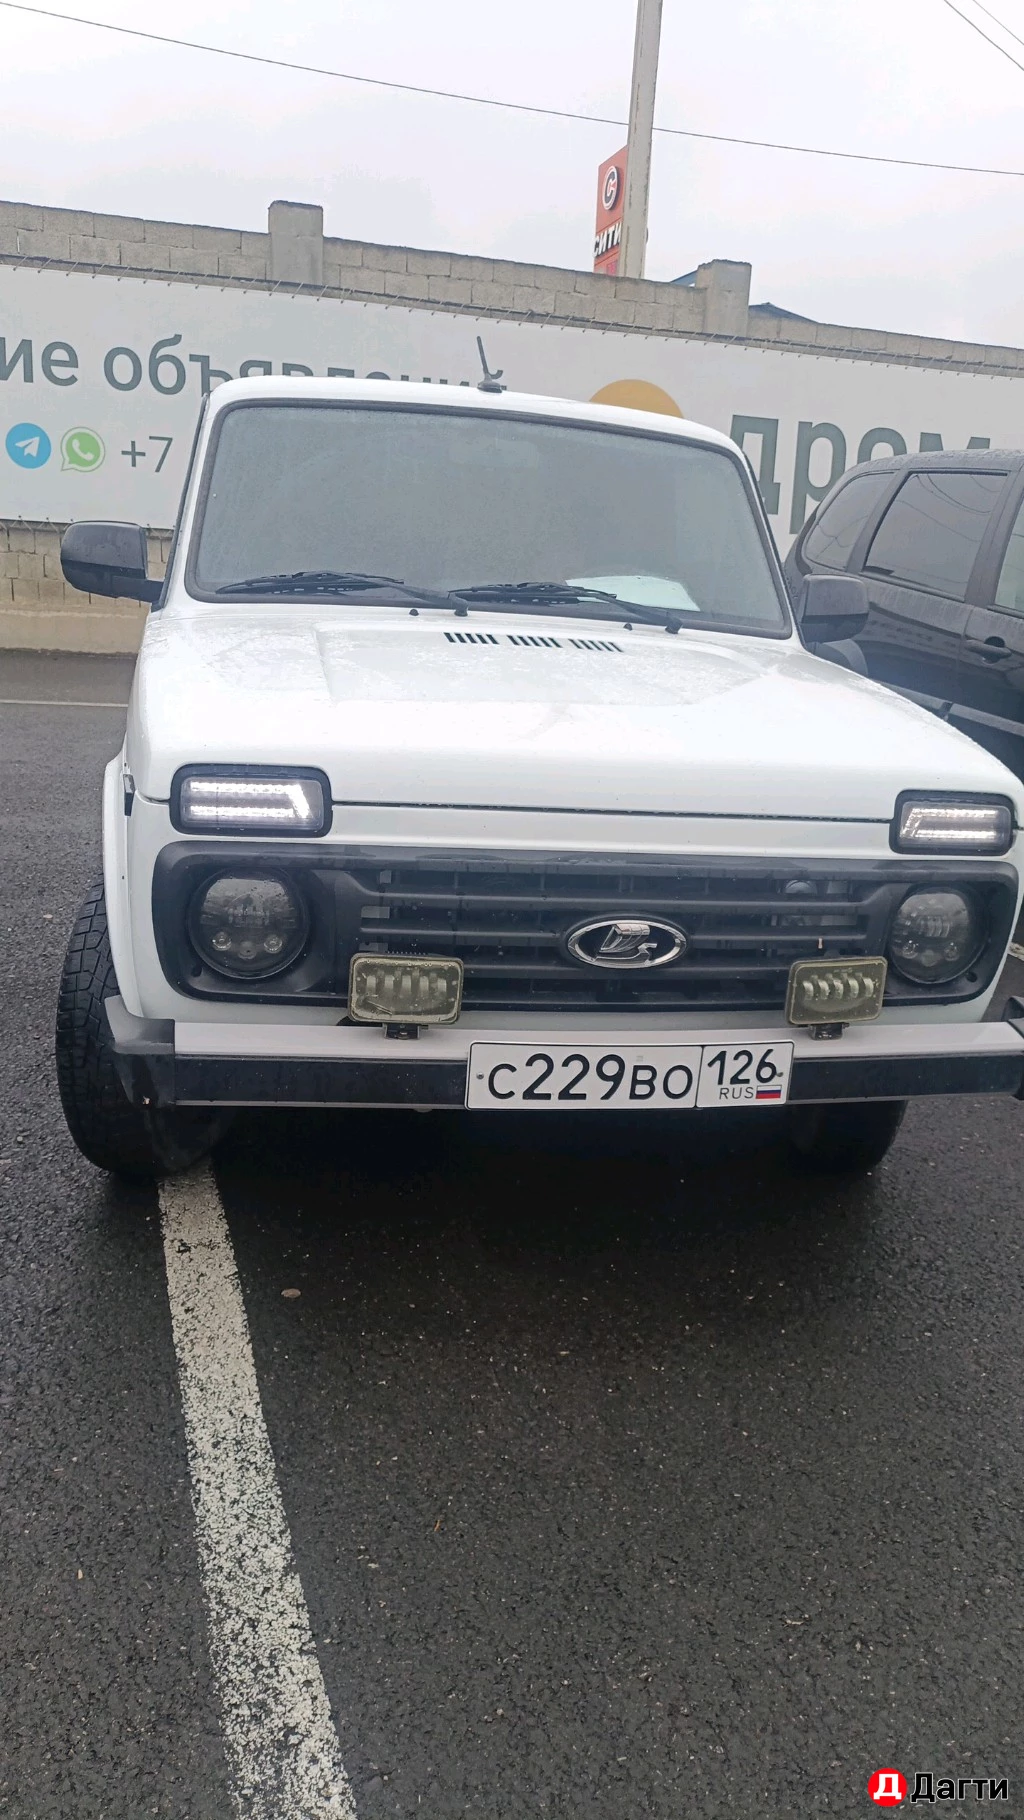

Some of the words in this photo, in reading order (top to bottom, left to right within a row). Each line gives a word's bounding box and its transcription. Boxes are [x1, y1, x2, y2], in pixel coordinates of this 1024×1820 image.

[121, 436, 173, 473] +7
[728, 414, 990, 534] др
[488, 1053, 693, 1100] С229ВО
[707, 1049, 778, 1085] 126
[719, 1087, 754, 1099] RUS
